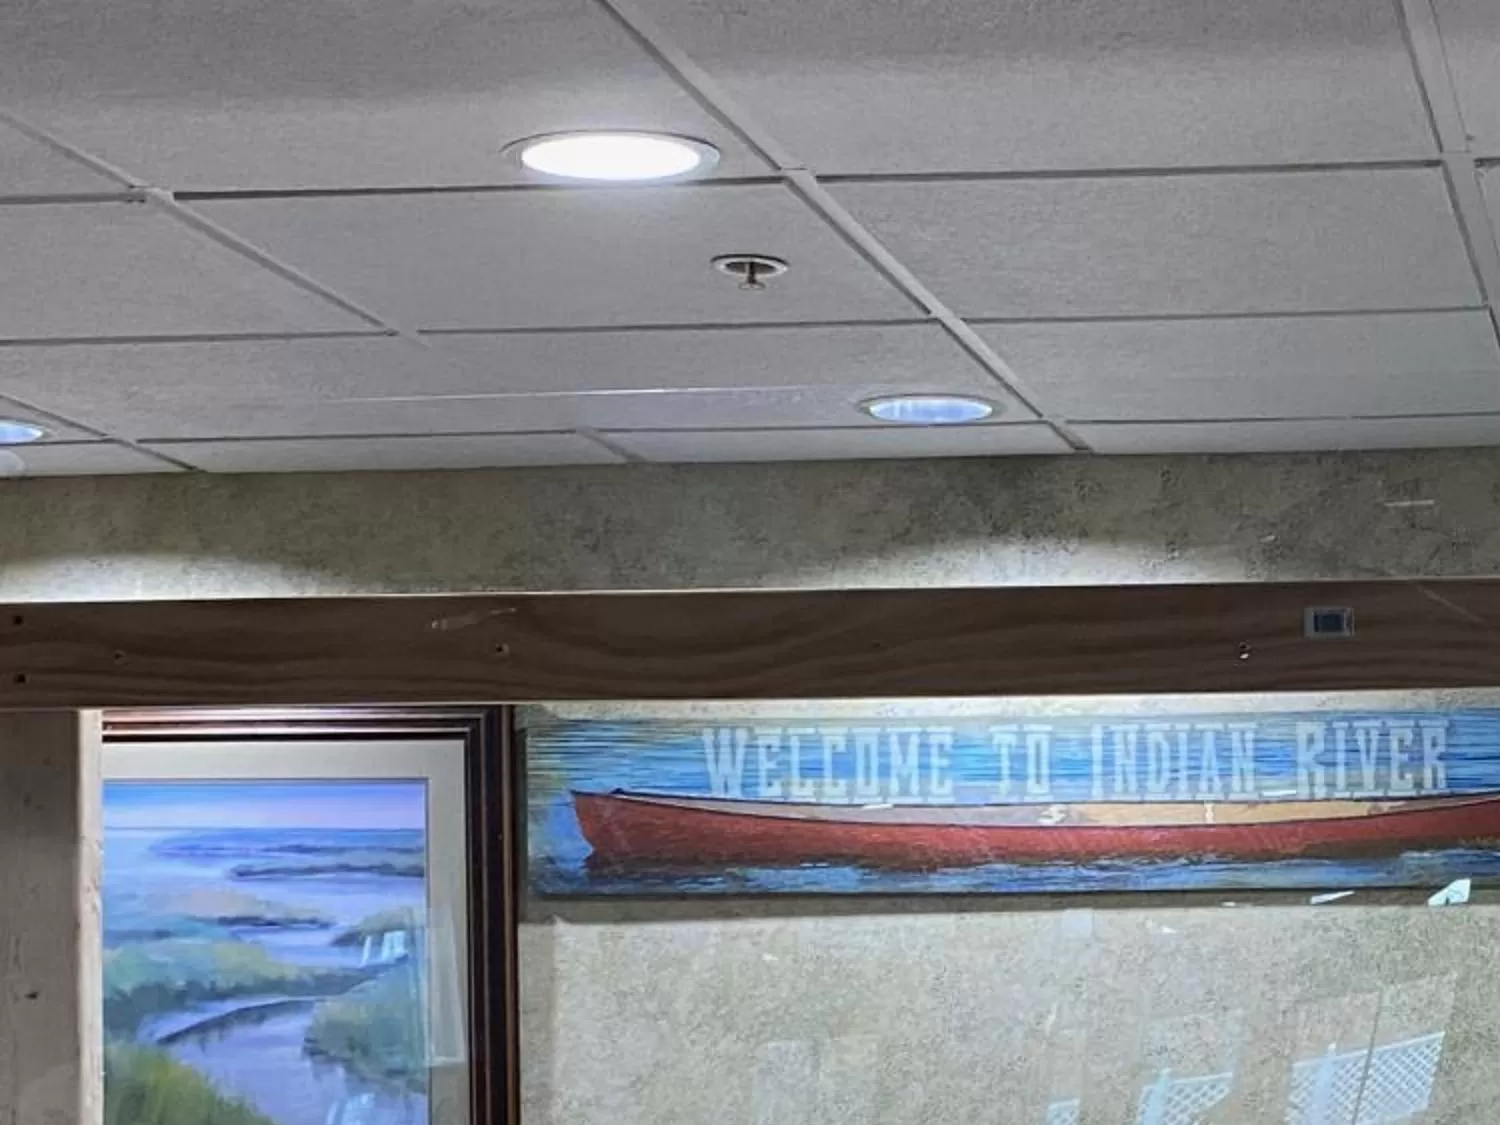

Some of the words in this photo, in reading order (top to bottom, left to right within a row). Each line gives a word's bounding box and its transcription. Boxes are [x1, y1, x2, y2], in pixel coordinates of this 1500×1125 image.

[702, 726, 953, 802] WELCOME
[988, 724, 1053, 802] TO
[1091, 722, 1260, 801] INDIAN
[1296, 720, 1448, 799] RIVER
